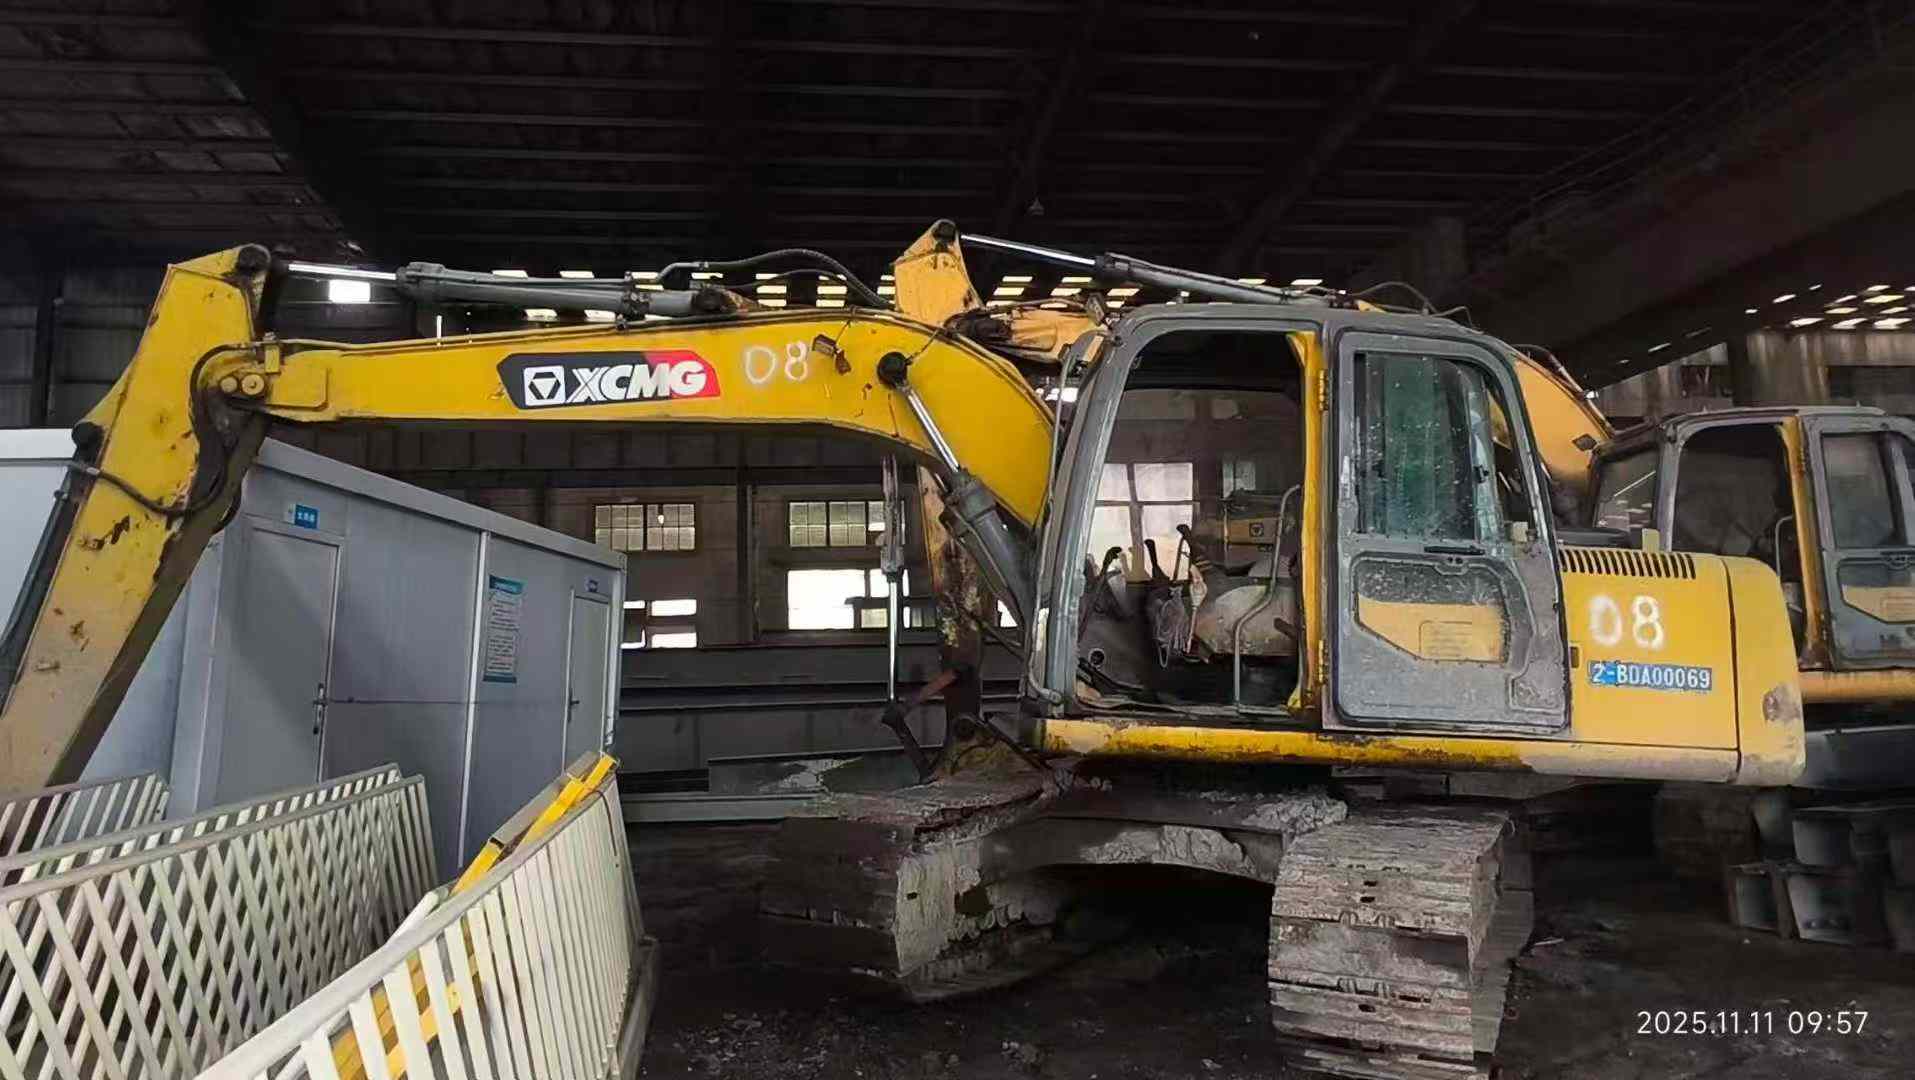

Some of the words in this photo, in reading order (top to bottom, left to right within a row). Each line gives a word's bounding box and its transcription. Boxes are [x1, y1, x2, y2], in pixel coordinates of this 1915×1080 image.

[566, 360, 707, 403] XCMG
[744, 340, 809, 384] 08
[1590, 594, 1664, 650] 08
[1592, 663, 1710, 689] 2-BDA00069
